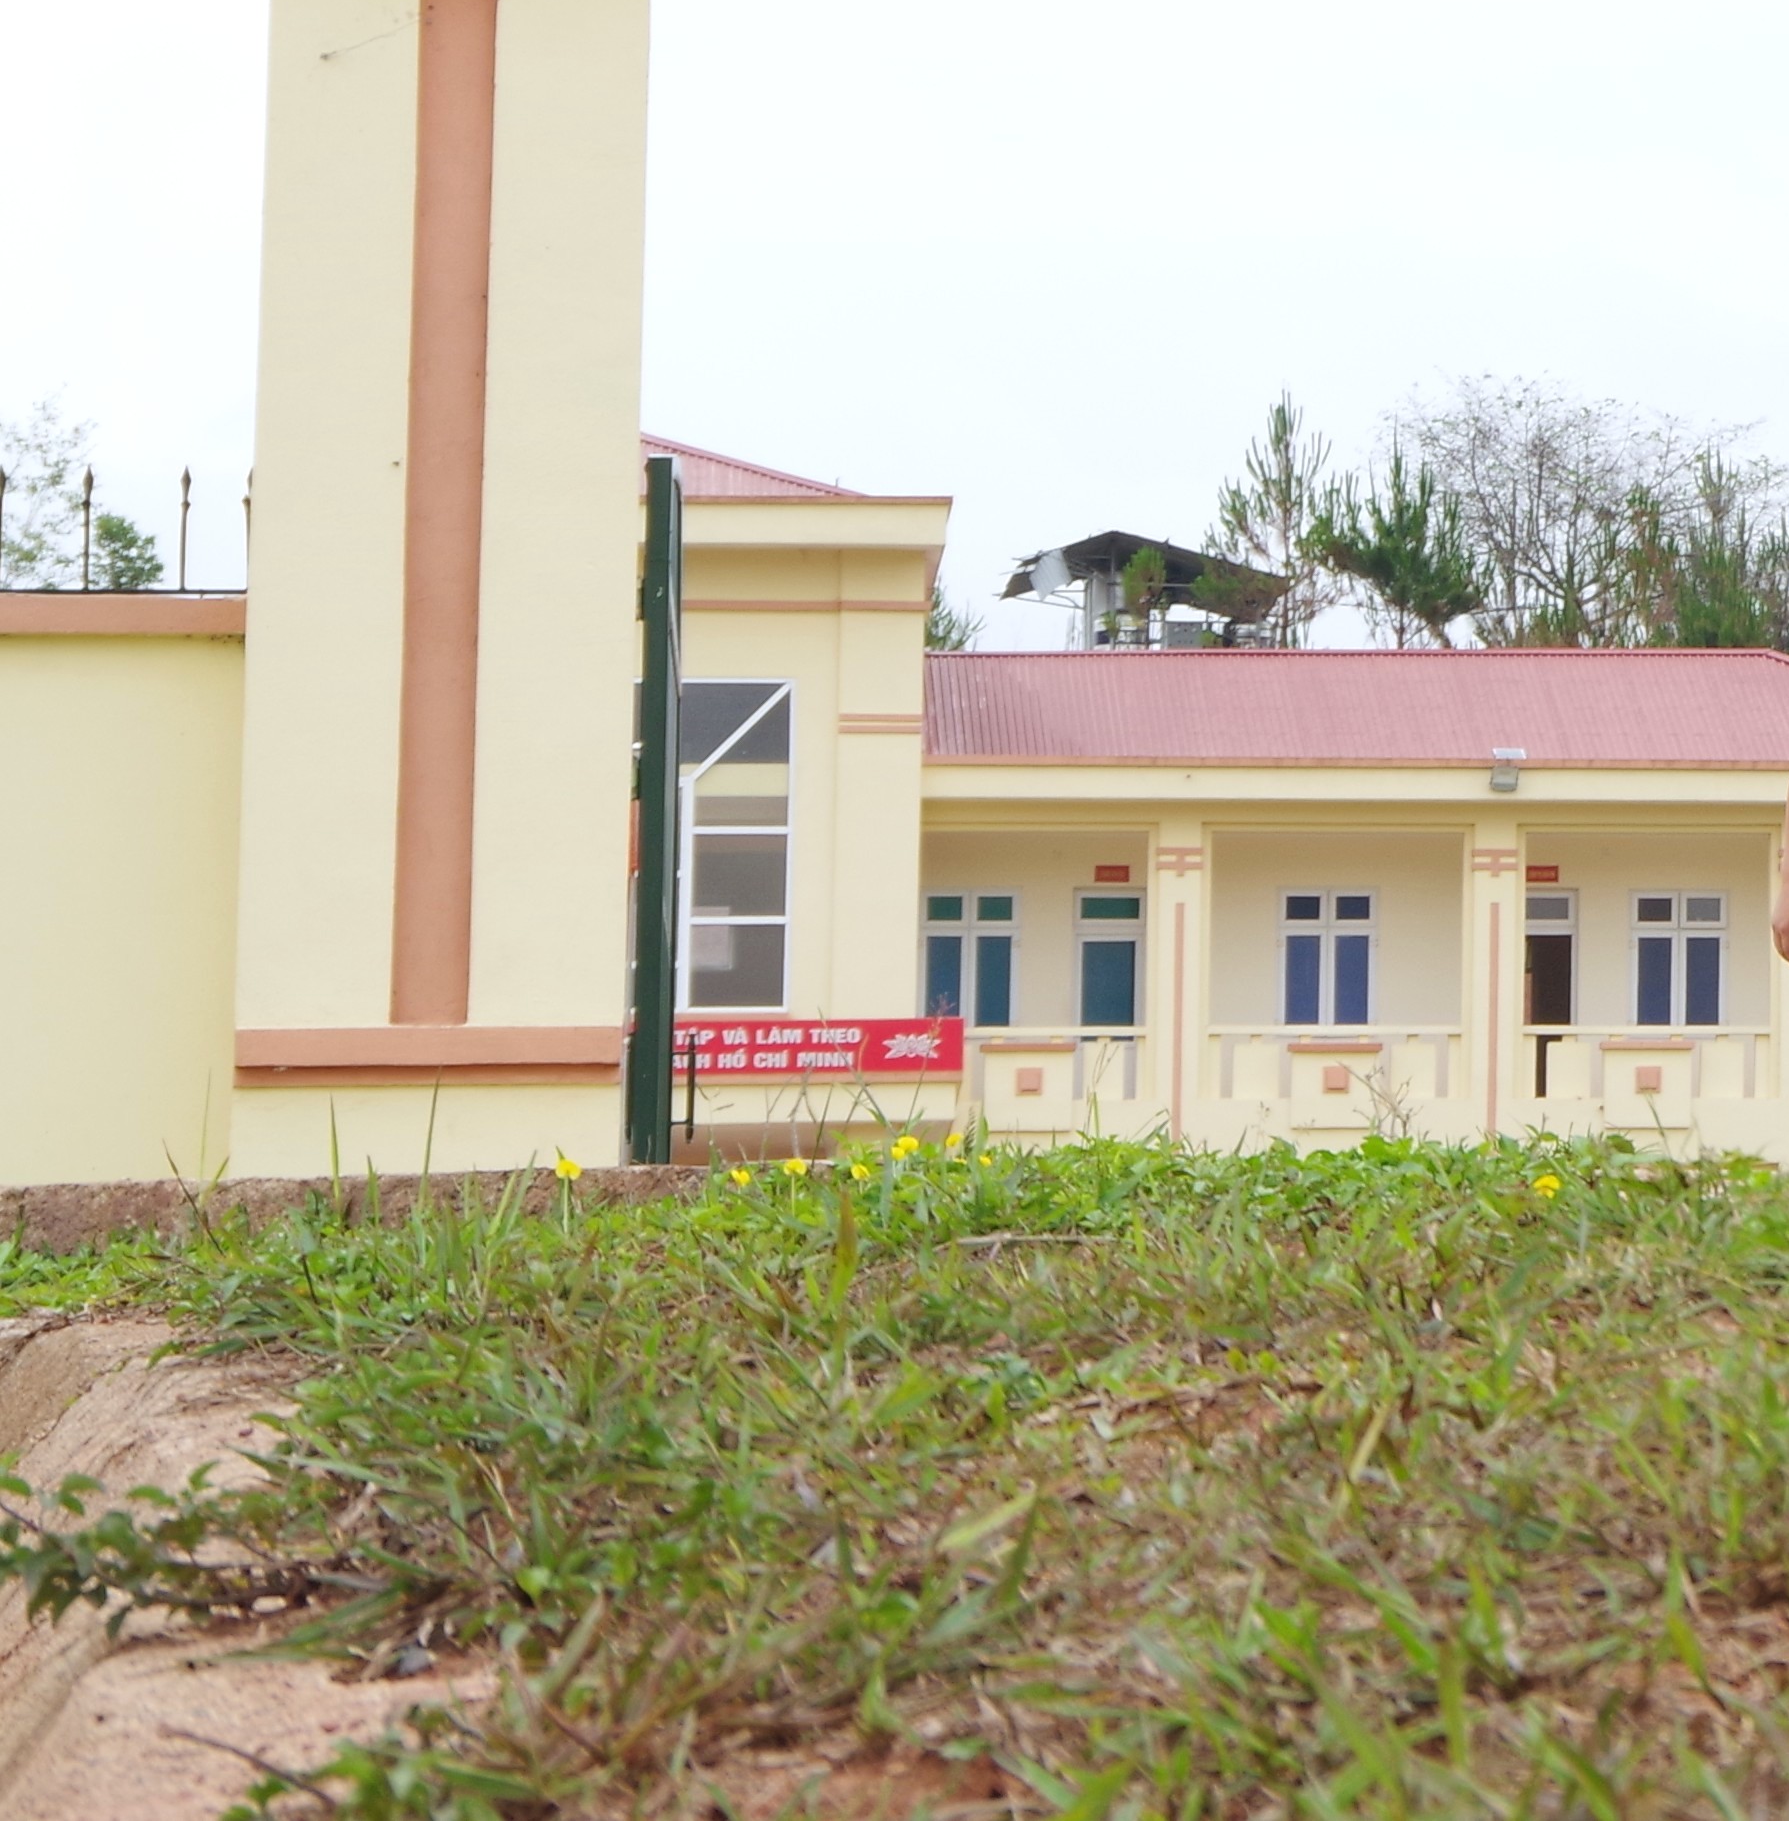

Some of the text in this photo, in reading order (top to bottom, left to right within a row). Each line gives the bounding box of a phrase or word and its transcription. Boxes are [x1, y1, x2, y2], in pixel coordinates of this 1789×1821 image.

[809, 1026, 862, 1045] THEO
[752, 1049, 789, 1069] CHÍ
[796, 1051, 855, 1068] MINH
